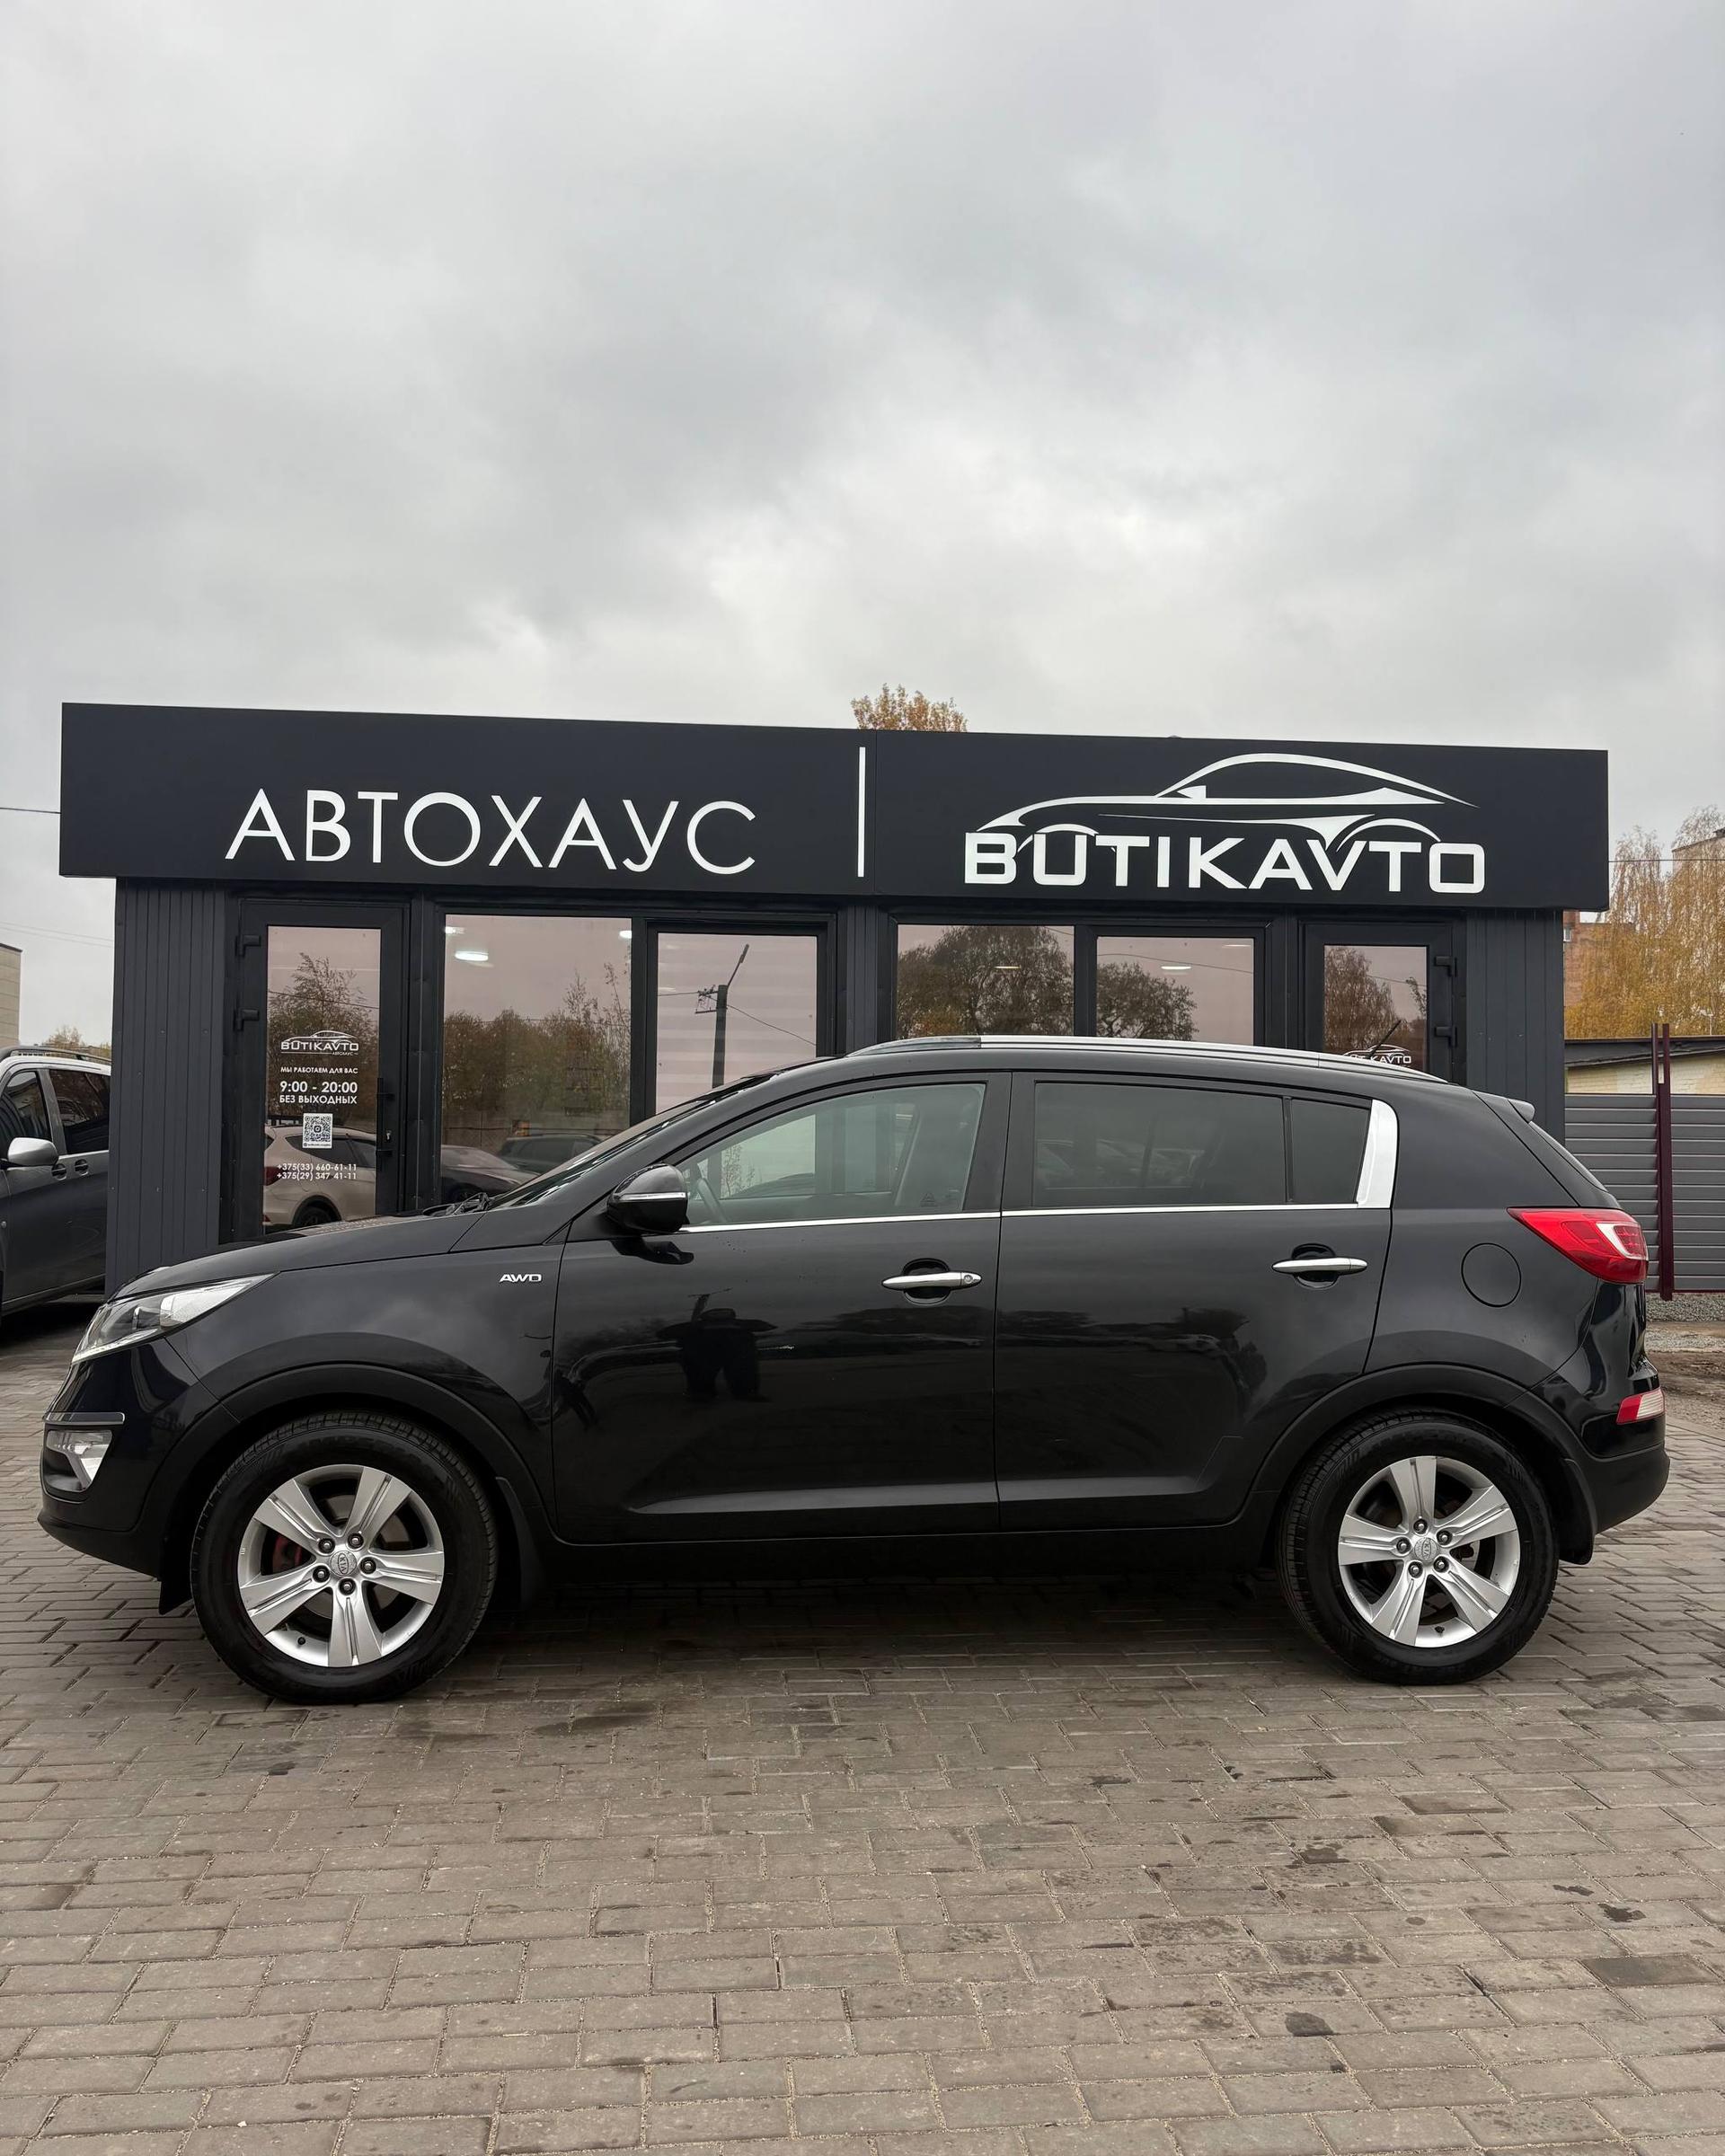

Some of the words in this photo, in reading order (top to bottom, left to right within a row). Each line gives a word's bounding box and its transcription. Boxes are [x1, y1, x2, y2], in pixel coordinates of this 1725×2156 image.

[225, 787, 756, 875] АВТОХАУС
[964, 831, 1486, 894] BUTIKAVTO
[280, 1041, 358, 1051] BUTIKAVTO
[279, 1080, 308, 1092] 9:00
[321, 1081, 358, 1093] 20:00
[279, 1095, 296, 1103] БЕЗ
[298, 1095, 358, 1104] ВЫХОДНЫХ
[277, 1163, 314, 1172] +375(33)
[315, 1163, 357, 1171] 660-61-11
[277, 1171, 313, 1181] +375(29)
[499, 1273, 542, 1283] AWD
